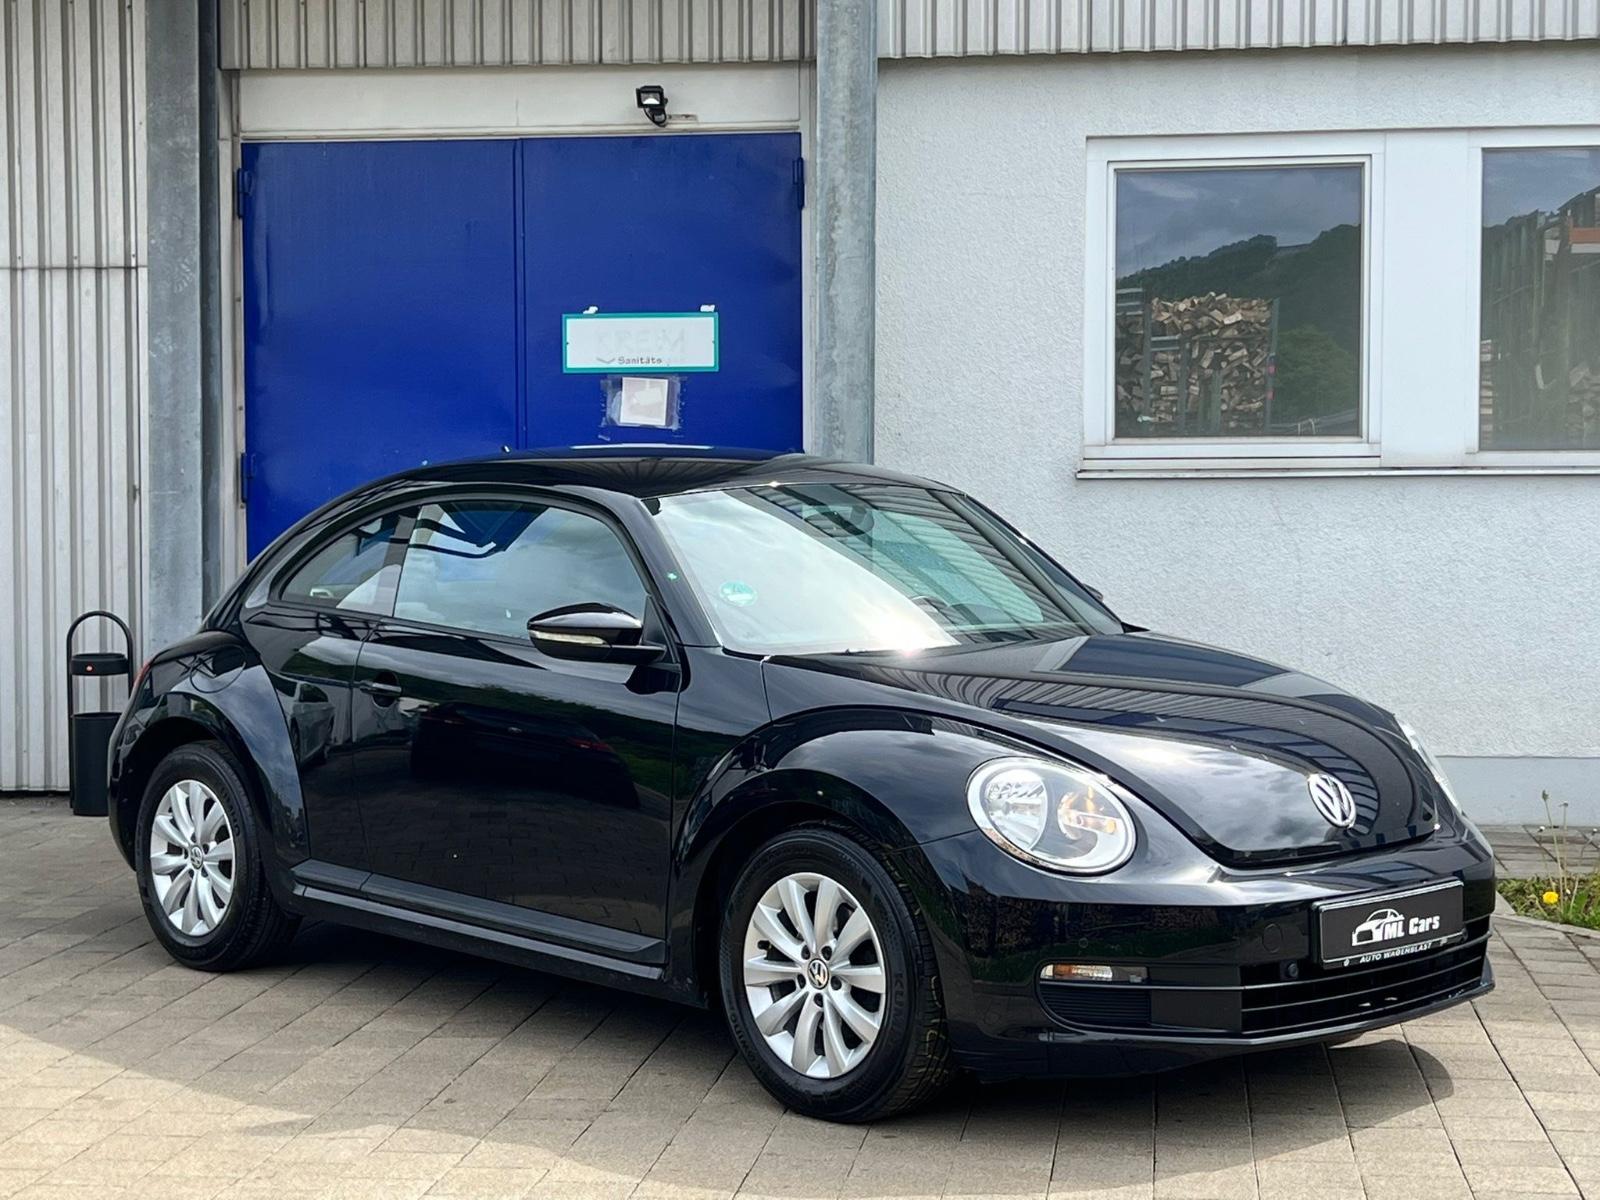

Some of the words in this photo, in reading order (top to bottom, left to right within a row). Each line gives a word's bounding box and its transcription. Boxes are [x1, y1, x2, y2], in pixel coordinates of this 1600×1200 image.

[1384, 921, 1405, 940] ML
[1409, 915, 1440, 935] Cars
[1360, 953, 1381, 963] AUTO
[1384, 942, 1432, 959] WAGENBLAST
